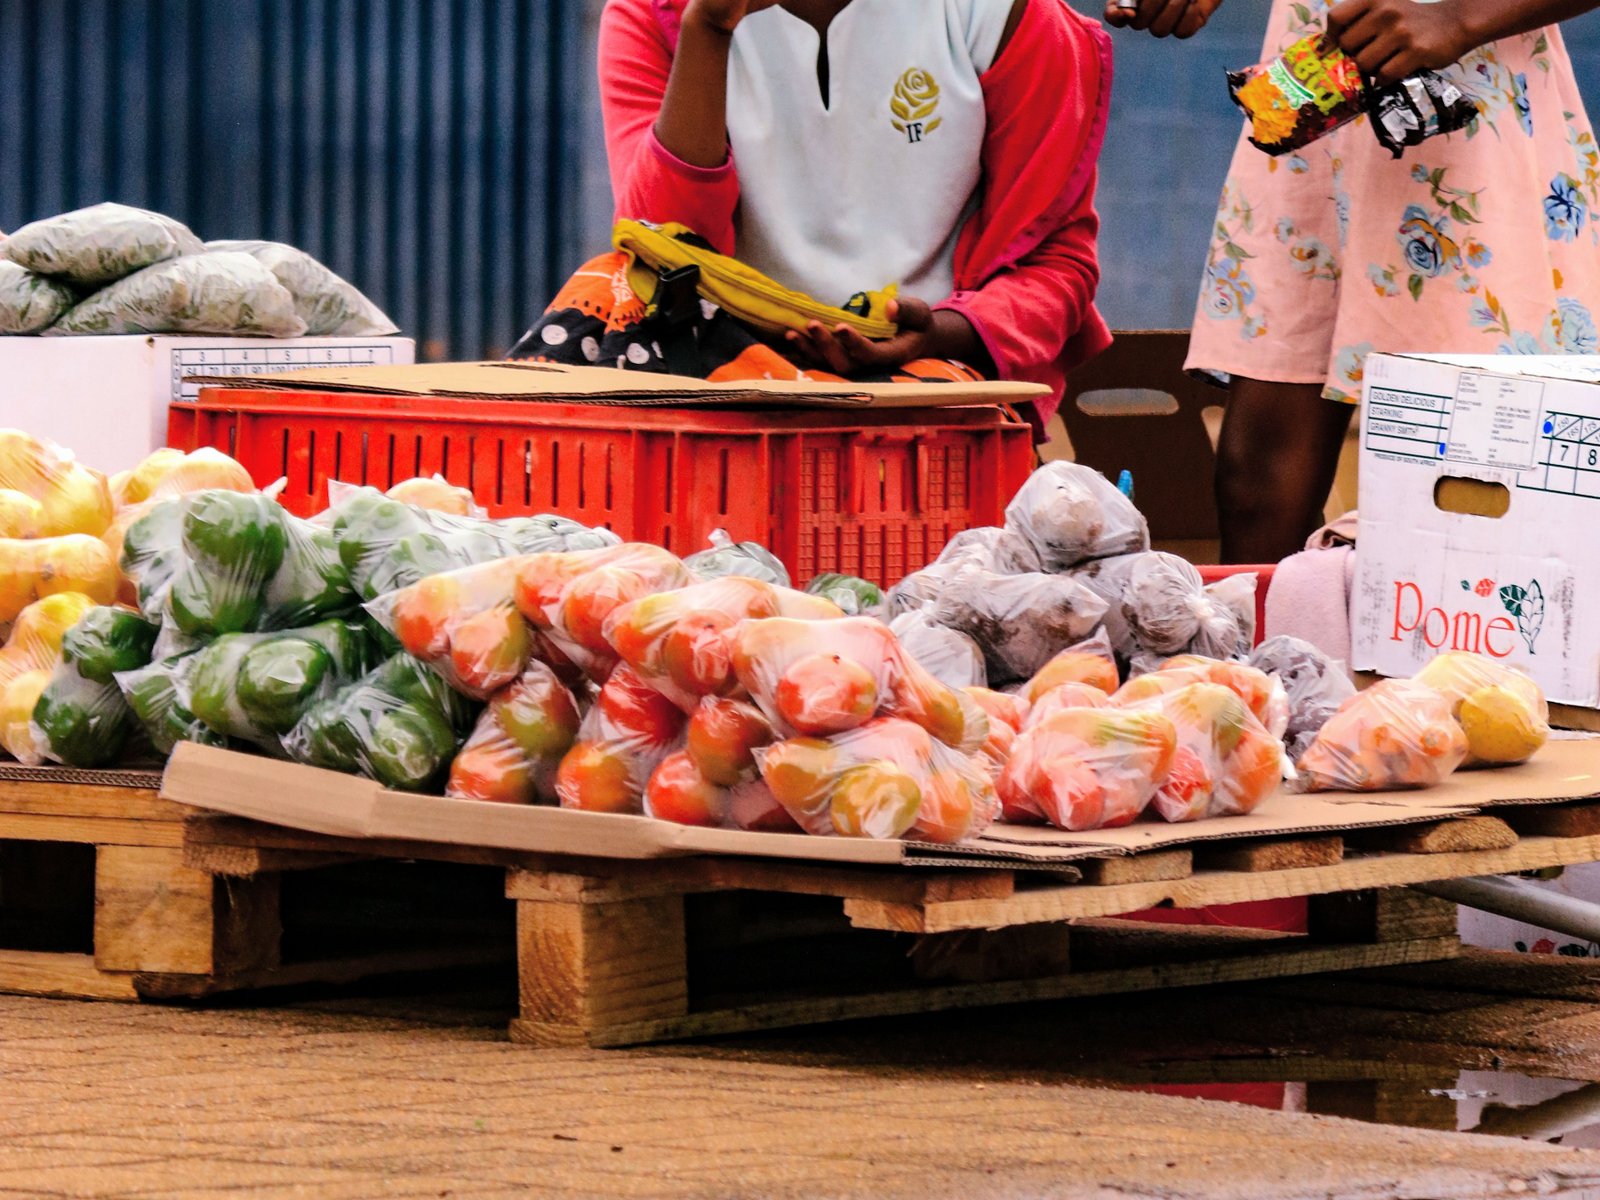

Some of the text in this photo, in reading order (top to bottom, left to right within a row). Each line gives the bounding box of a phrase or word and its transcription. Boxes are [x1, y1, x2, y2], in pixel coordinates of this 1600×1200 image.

[905, 122, 923, 144] IF
[1373, 391, 1436, 408] GOLDEN DELICIOUS
[1371, 406, 1404, 419] STARKING
[1371, 422, 1396, 433] GRANNY
[1560, 444, 1597, 466] 7 8
[1390, 580, 1516, 658] Pome
